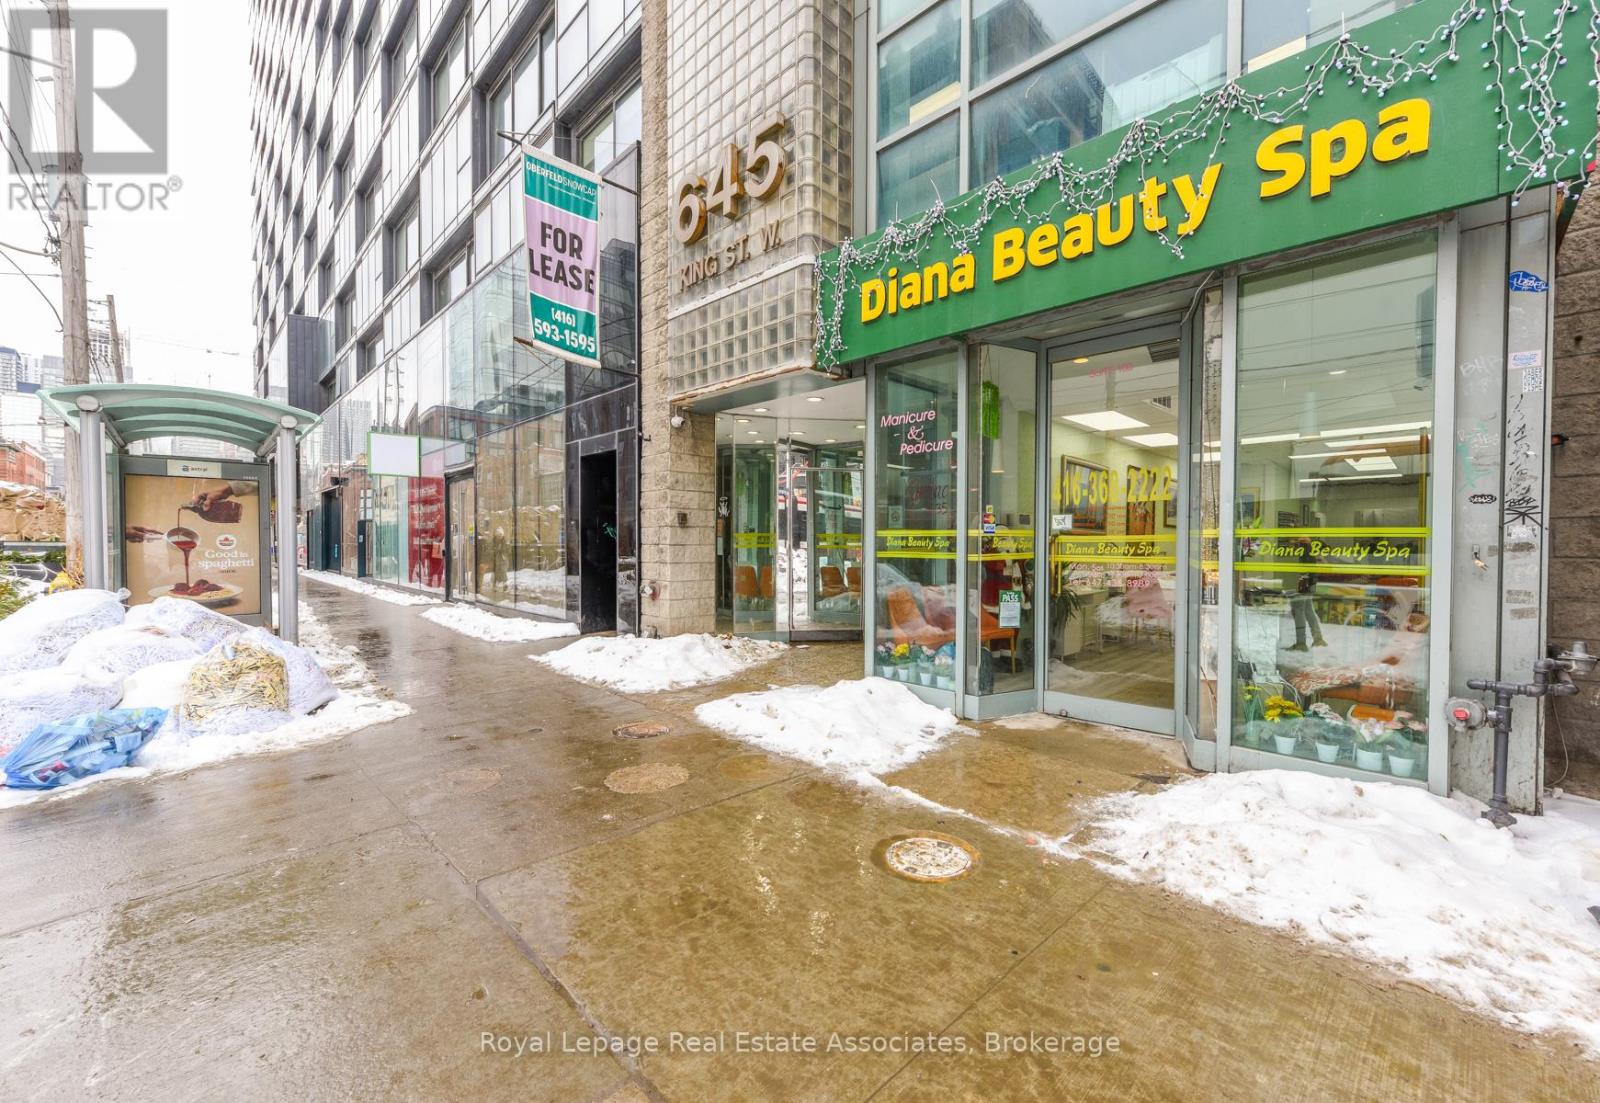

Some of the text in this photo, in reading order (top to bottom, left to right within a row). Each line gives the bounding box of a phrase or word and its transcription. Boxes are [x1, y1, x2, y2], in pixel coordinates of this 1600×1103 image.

[676, 112, 786, 246] 645
[861, 98, 1432, 323] Diana Beauty Spa
[541, 221, 583, 260] FOR
[679, 219, 784, 291] KING ST. W.
[529, 248, 595, 295] LEASE
[551, 307, 576, 327] (416)
[534, 318, 596, 354] 593-1595
[880, 409, 936, 428] Manicure
[907, 424, 925, 440] &
[899, 438, 954, 455] Pedicure
[886, 535, 950, 550] Diana Beauty Spa
[1065, 542, 1161, 556] Diana Beauty Spa
[1259, 540, 1411, 562] Diana Beauty Spa
[197, 558, 254, 570] spaghetti
[204, 550, 238, 559] Good
[1002, 594, 1019, 602] PASS
